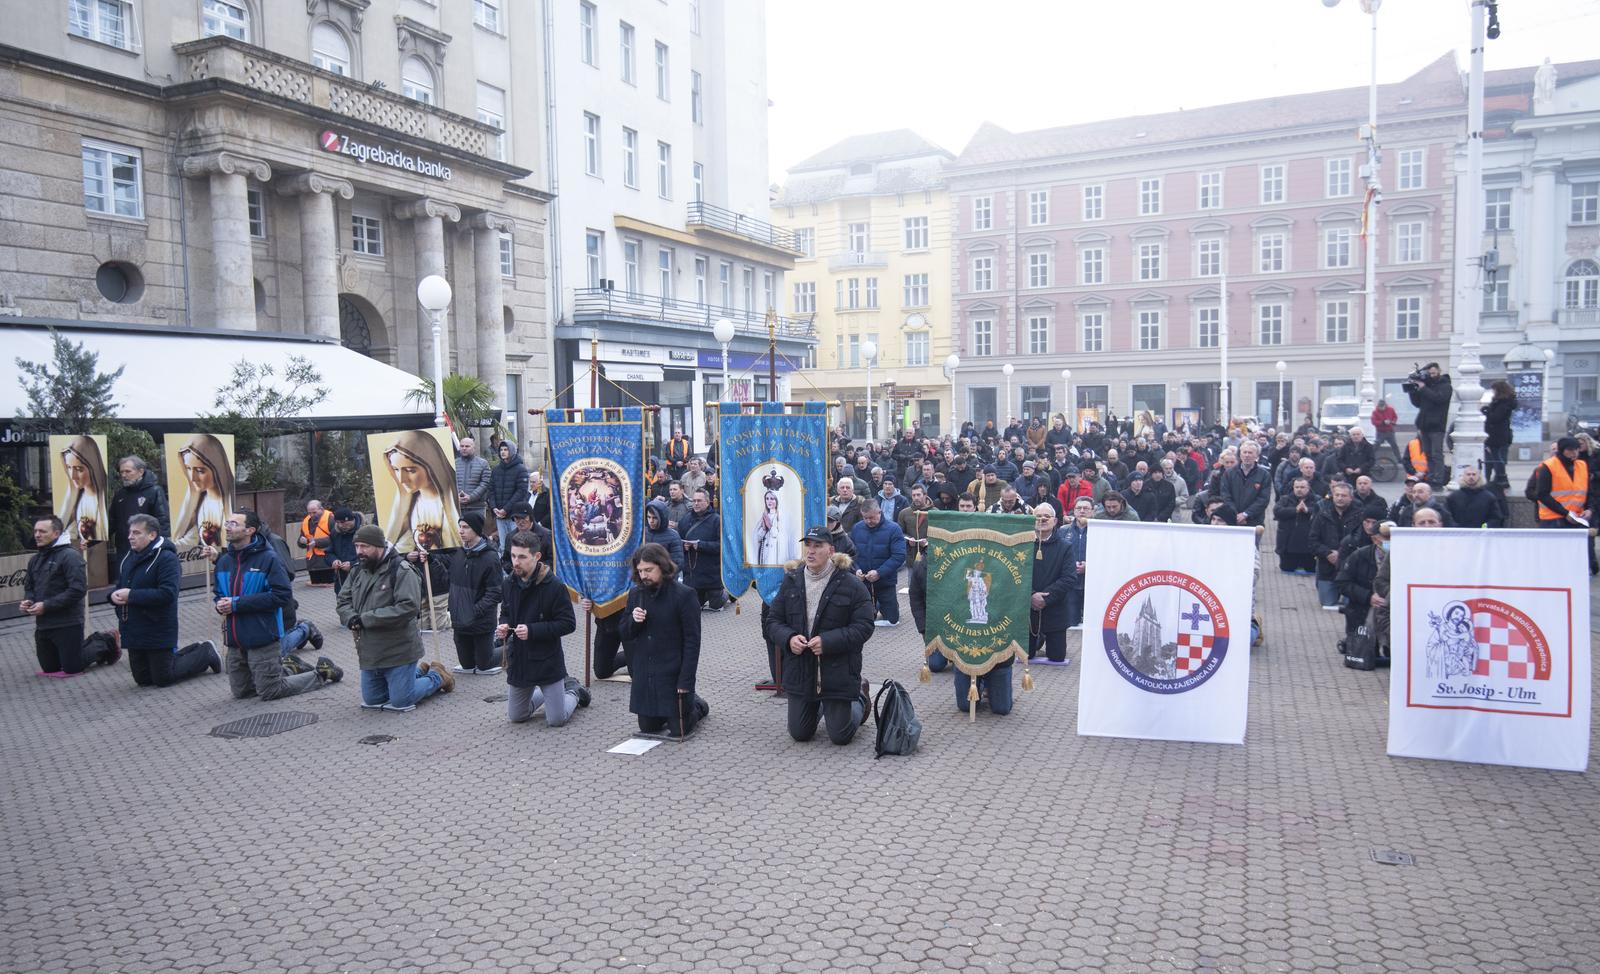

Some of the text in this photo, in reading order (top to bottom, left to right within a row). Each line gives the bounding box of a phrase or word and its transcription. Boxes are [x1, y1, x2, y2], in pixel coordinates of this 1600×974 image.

[340, 135, 452, 180] Zagrebačka banka
[1521, 375, 1540, 384] 33.
[552, 436, 637, 450] GOSPO OD KRUNICE
[726, 428, 762, 446] GOSPA
[566, 446, 588, 456] MOLI
[606, 447, 623, 456] NAS
[736, 440, 810, 458] MOLI ZA NAS
[933, 558, 952, 580] Sveti
[950, 544, 986, 561] Mihaele
[1108, 574, 1226, 628] KROATISCHE KATHOLISCHE GEMEINDE ULM
[943, 612, 1014, 637] brani nas u boju!
[1478, 602, 1511, 616] Hrvatska
[1534, 637, 1547, 672] zajednica
[1110, 648, 1134, 678] HRVATSKA
[1174, 670, 1210, 690] ZAJEDNICA
[1206, 657, 1220, 674] ULM
[1436, 682, 1456, 695] Sv.
[1458, 684, 1495, 700] Josip
[1507, 686, 1536, 700] Ulm
